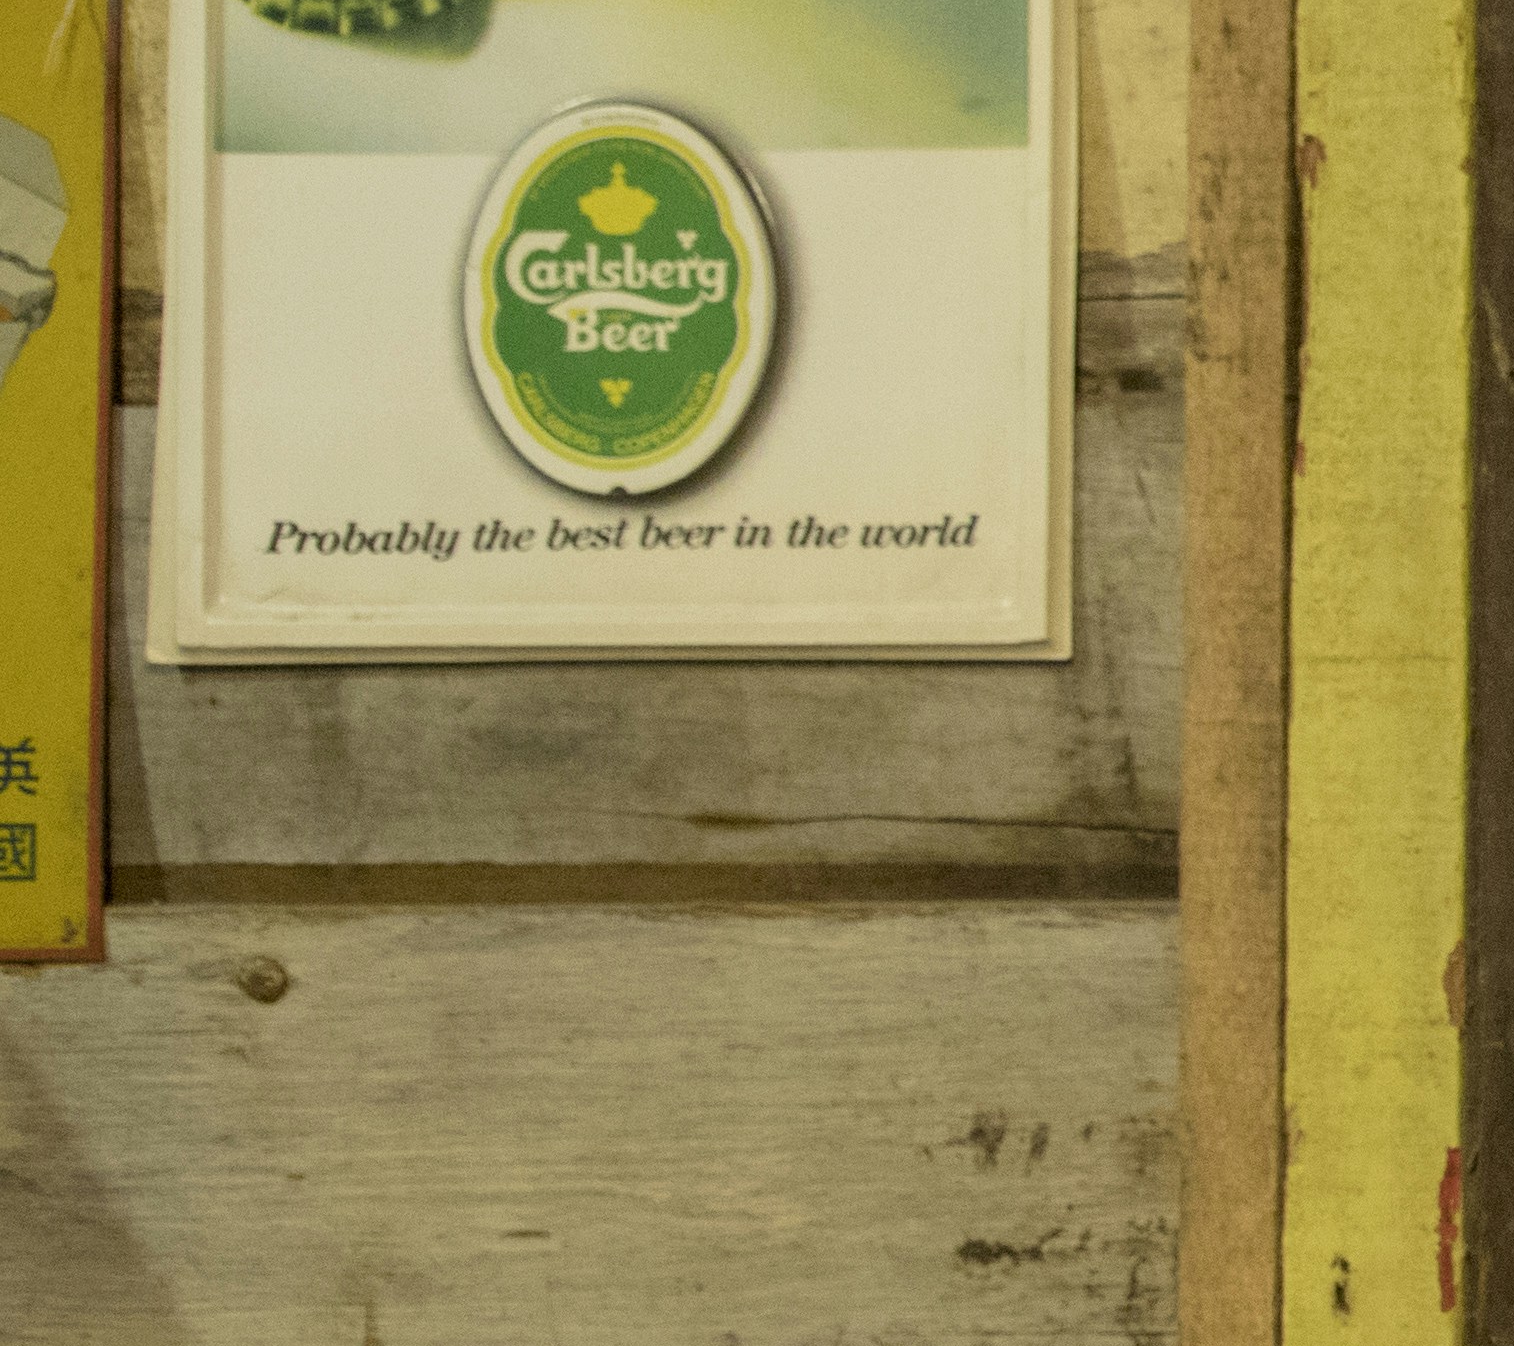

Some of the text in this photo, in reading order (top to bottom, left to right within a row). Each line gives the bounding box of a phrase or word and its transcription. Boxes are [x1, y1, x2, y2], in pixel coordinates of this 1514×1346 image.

[504, 229, 729, 306] Carlsberg
[563, 307, 681, 353] Beer
[266, 513, 980, 563] Probably the best beer in the world
